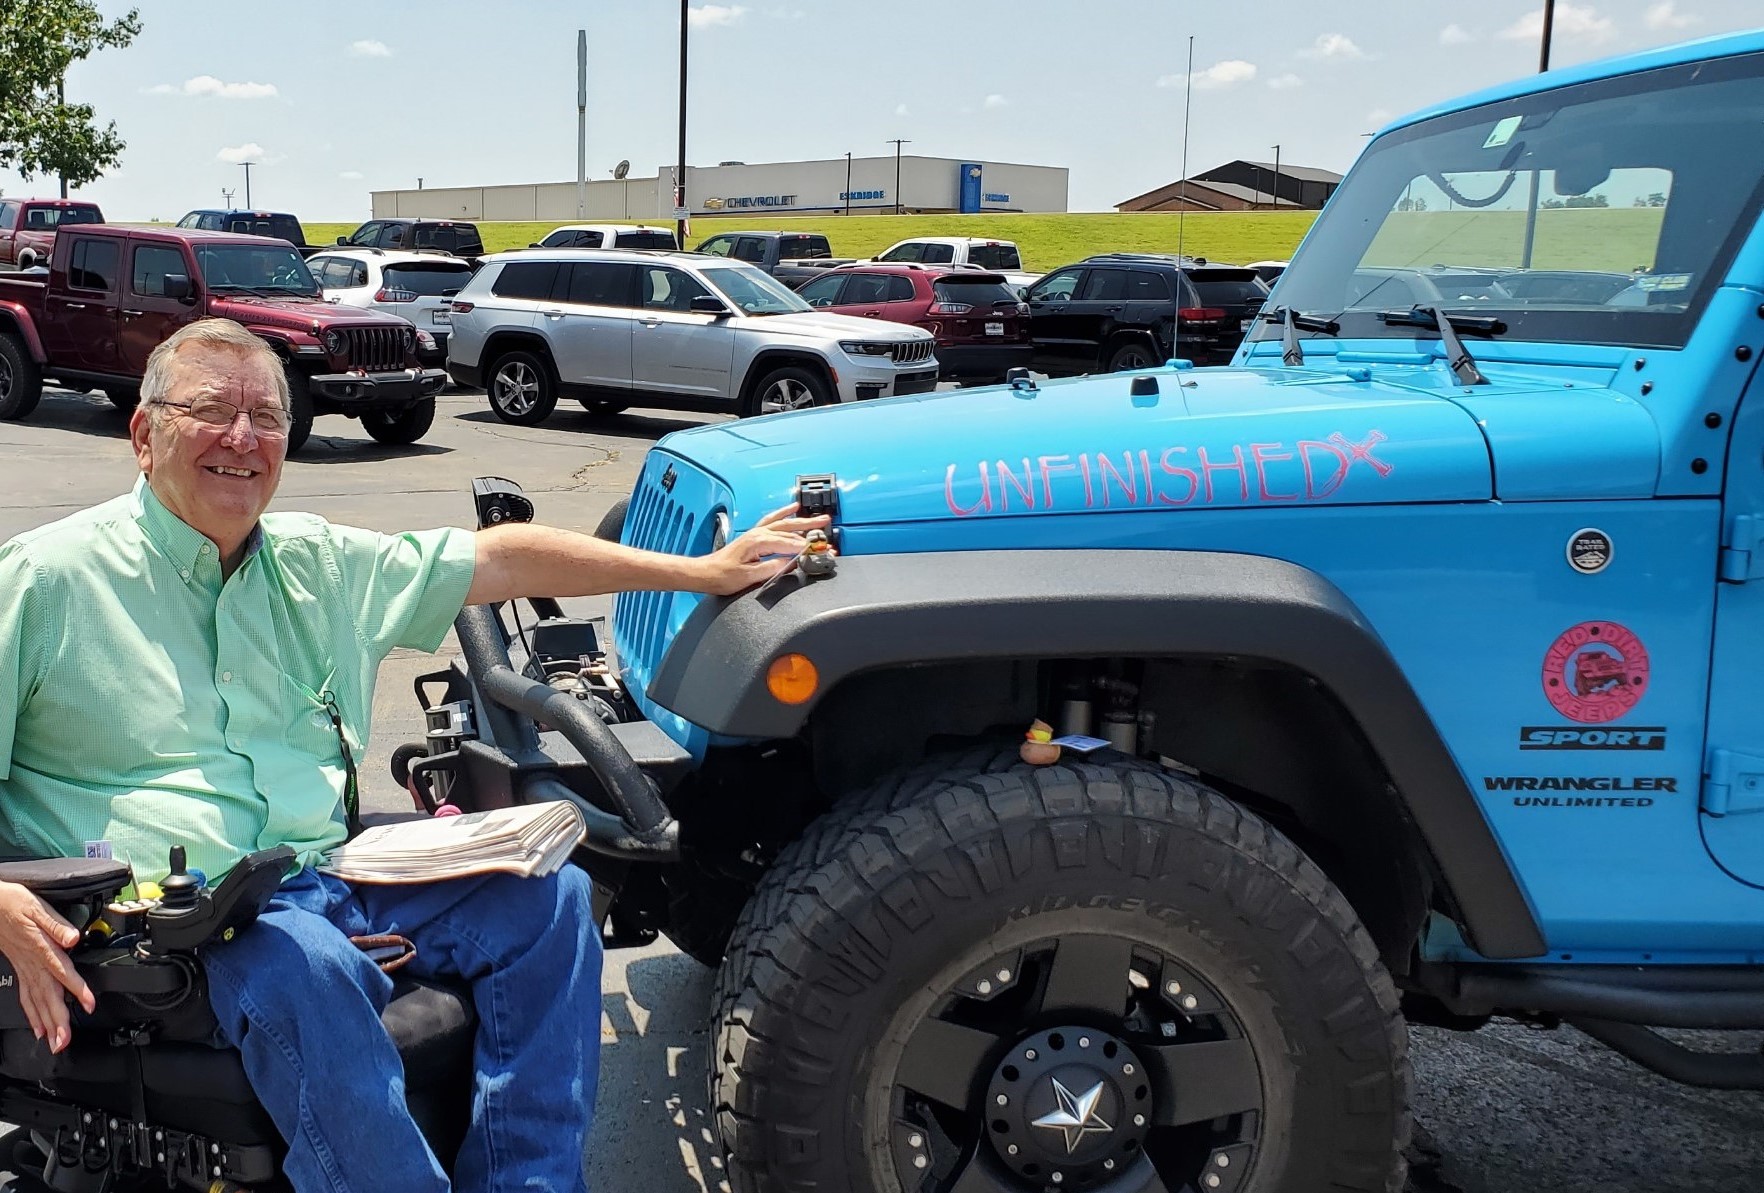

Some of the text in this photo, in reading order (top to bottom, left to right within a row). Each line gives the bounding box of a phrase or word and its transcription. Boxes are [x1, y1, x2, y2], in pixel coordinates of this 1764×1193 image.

[726, 195, 798, 208] CHEVROLET
[1525, 729, 1662, 747] SPORT
[1483, 776, 1678, 793] WRANGLER
[1513, 797, 1654, 808] UNLIMITED
